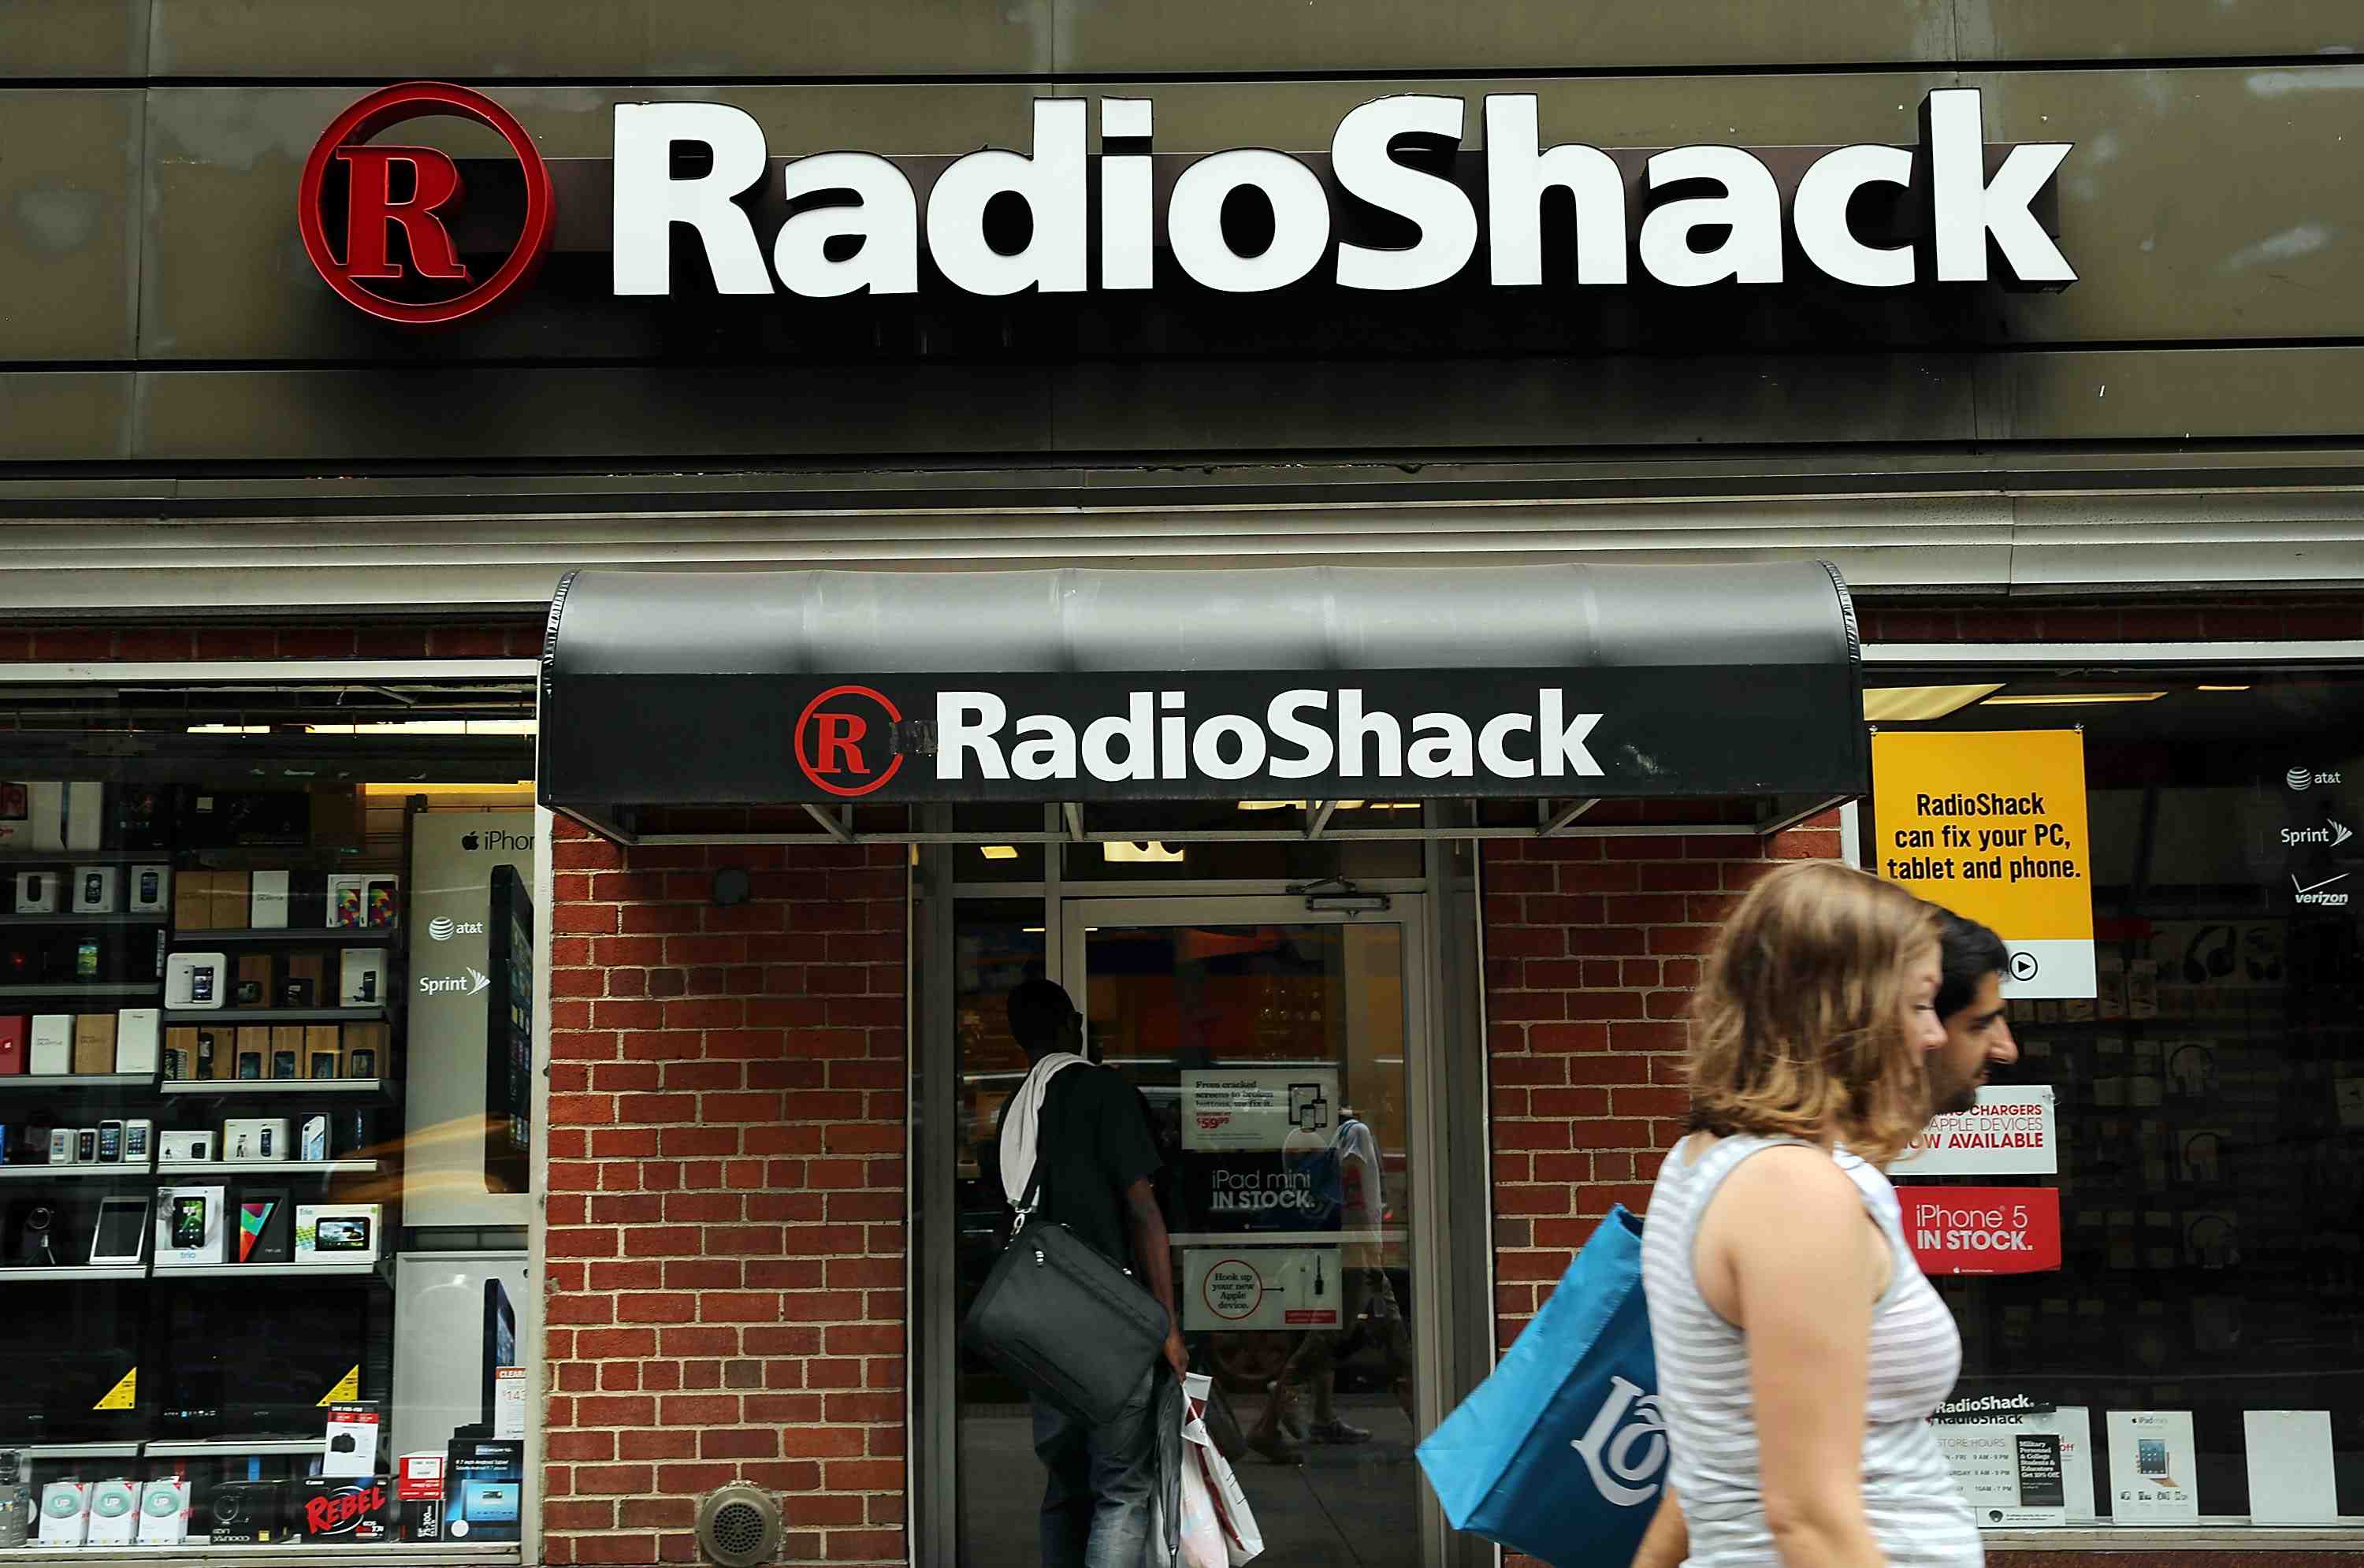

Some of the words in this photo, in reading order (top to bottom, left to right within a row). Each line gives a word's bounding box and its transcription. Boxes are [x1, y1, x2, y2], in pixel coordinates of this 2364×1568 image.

[612, 87, 2079, 298] RadioShack
[936, 687, 1604, 781] RadioShack
[2314, 771, 2341, 784] at&t
[1916, 792, 2046, 816] RadioShack
[1894, 829, 1934, 848] can
[1942, 825, 1971, 847] fix
[1978, 828, 2028, 852] your
[2034, 823, 2071, 849] PC,
[2280, 827, 2330, 847] Sprint
[1886, 856, 1955, 879] tablet
[1962, 856, 2002, 879] and
[2010, 855, 2081, 883] phone.
[2295, 891, 2348, 905] verizon
[456, 921, 483, 934] at&t
[419, 976, 467, 995] Sprint
[1970, 1104, 2042, 1116] CHARGERS
[1929, 1118, 1974, 1131] APPLE
[1979, 1117, 2043, 1131] DEVICES
[1947, 1132, 2043, 1149] AVAILABLE
[1211, 1169, 1261, 1190] iPad
[1266, 1169, 1311, 1190] mini
[1211, 1191, 1233, 1209] IN
[2012, 1205, 2028, 1228] 5
[1916, 1229, 1942, 1250] IN
[1946, 1229, 2034, 1250] STOCK.
[1214, 1273, 1239, 1281] Hook
[1240, 1274, 1253, 1284] up
[1220, 1291, 1247, 1301] Apple
[1971, 1438, 2005, 1447] HOURS
[304, 1487, 386, 1535] REBEL
